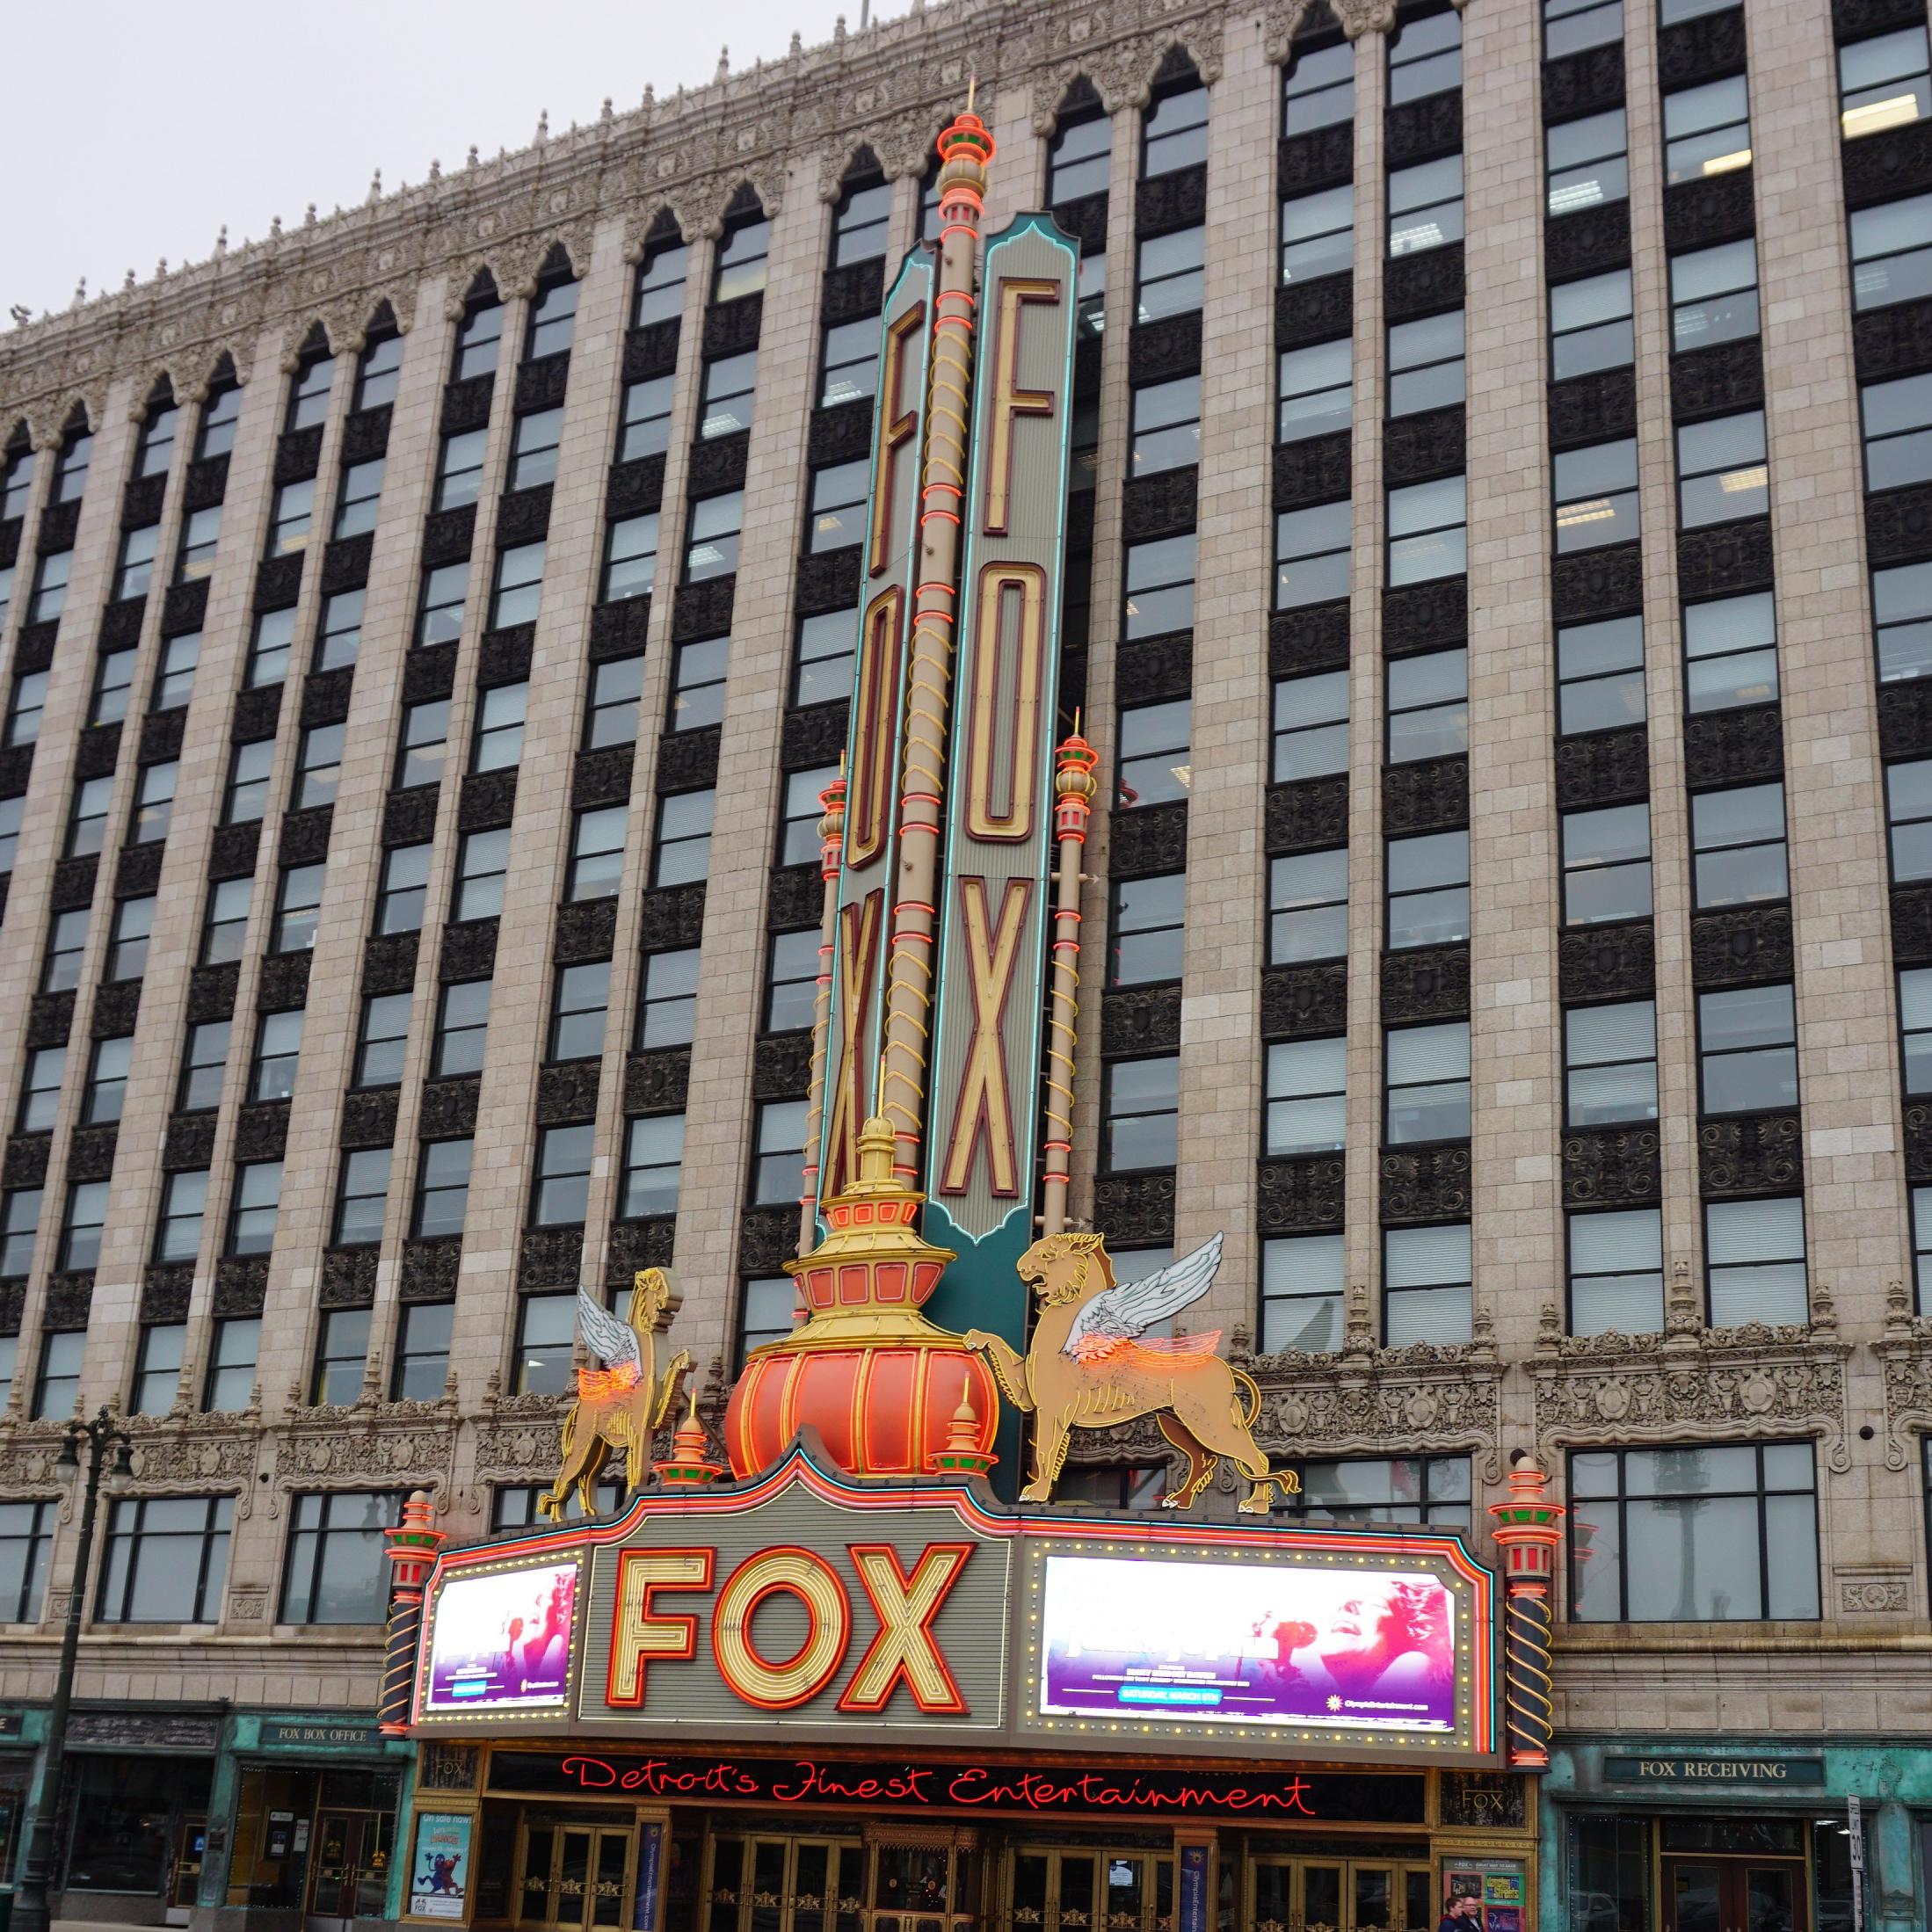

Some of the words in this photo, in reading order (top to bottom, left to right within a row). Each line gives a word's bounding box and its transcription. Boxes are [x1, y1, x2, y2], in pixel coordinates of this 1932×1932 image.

[823, 300, 925, 1198] FOX
[940, 277, 1060, 1198] FOX
[605, 1542, 978, 1715] FOX
[279, 1727, 300, 1740] FOX
[303, 1728, 325, 1740] BOX
[330, 1729, 367, 1741] OFFICE
[435, 1759, 464, 1775] FOX
[1638, 1761, 1678, 1776] FOX
[1683, 1762, 1788, 1778] RECEIVING
[562, 1757, 759, 1794] Detroit's
[773, 1761, 933, 1802] Finest
[948, 1769, 1315, 1814] Entertainment
[1463, 1790, 1504, 1811] FOX
[1852, 1834, 1861, 1861] 30
